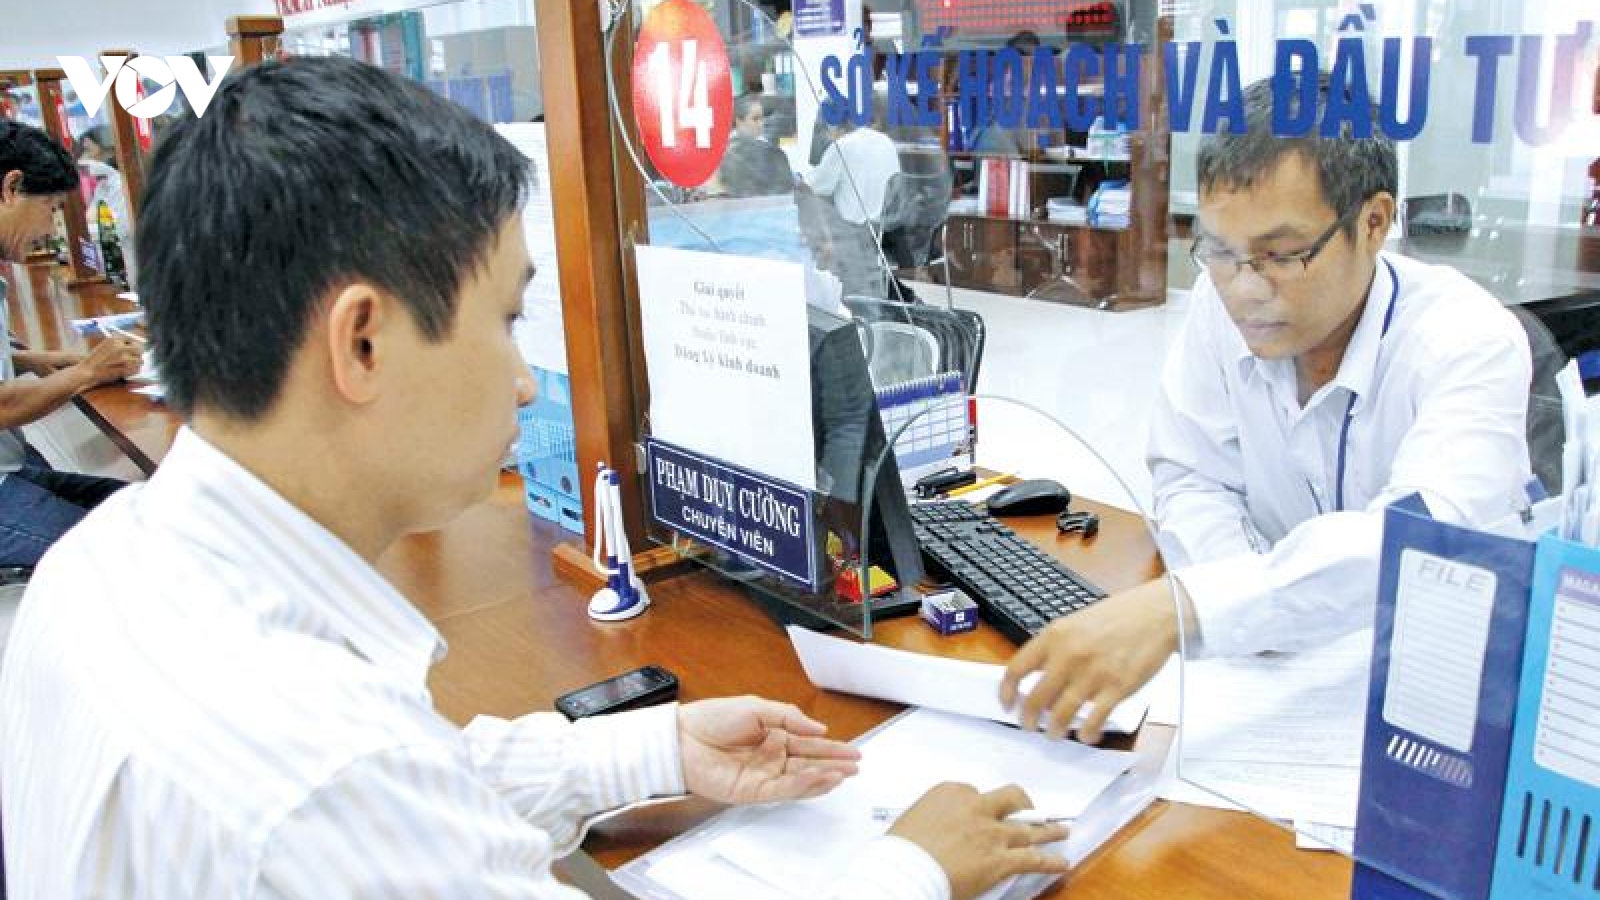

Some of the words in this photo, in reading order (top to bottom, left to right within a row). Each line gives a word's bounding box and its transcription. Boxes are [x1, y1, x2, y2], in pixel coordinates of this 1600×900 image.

[646, 39, 714, 149] 14
[820, 27, 874, 126] SỞ
[959, 42, 1142, 148] HOẠCH
[1164, 19, 1248, 133] VÀ
[1270, 4, 1433, 141] ĐẦU
[1465, 20, 1593, 147] TƯ
[655, 457, 700, 500] PHẠM
[702, 473, 735, 513] DUY
[739, 486, 801, 539] CƯỜNG
[681, 505, 737, 541] CHUYÊN
[739, 527, 774, 557] VIÊN
[1418, 559, 1489, 593] FILE
